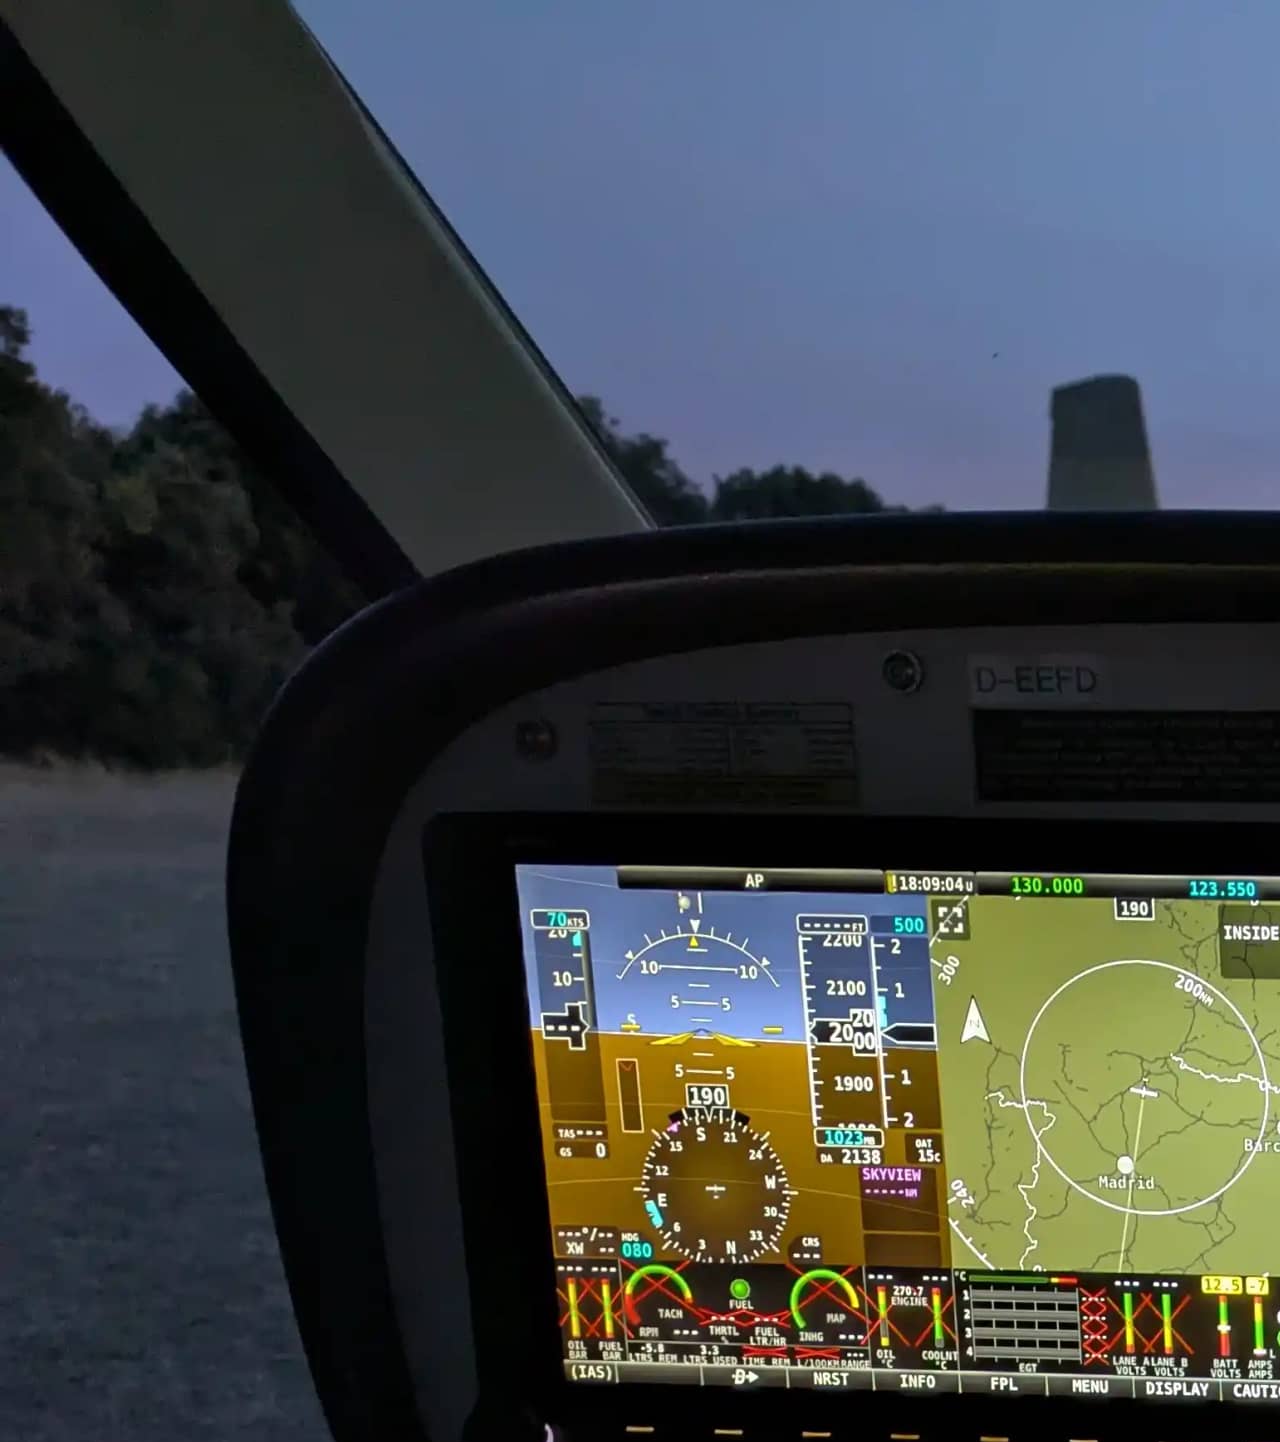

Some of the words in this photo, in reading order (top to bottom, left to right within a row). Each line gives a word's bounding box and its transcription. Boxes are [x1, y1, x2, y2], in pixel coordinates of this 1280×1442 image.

[975, 666, 1098, 693] D-EEFD
[745, 874, 764, 888] AP
[1012, 877, 1083, 894] 130.000
[1190, 880, 1256, 897] 123.550
[1120, 901, 1149, 916] 190
[894, 918, 924, 933] 500
[1223, 925, 1280, 940] INSIDE
[822, 934, 862, 948] 2200
[552, 972, 572, 986] 10
[826, 981, 866, 996] 2100
[834, 1076, 873, 1092] 1900
[690, 1088, 725, 1105] 190
[842, 1149, 881, 1164] 2138
[863, 1168, 922, 1182] SKYVIEW
[1099, 1176, 1154, 1189] Madrid
[566, 1242, 584, 1255] XW
[803, 1237, 820, 1247] CRS
[622, 1242, 652, 1257] 080
[893, 1286, 924, 1296] 270.7
[1203, 1278, 1240, 1292] 12.5
[730, 1300, 753, 1310] FUEL
[891, 1297, 928, 1306] ENGINE
[658, 1309, 683, 1319] TACH
[827, 1314, 846, 1323] MAP
[639, 1327, 658, 1337] RPM
[568, 1341, 587, 1351] OIL
[922, 1351, 958, 1361] COOLNT
[1019, 1364, 1038, 1373] EGT
[1214, 1360, 1238, 1369] BATT
[1249, 1360, 1272, 1370] AMPS
[571, 1366, 612, 1381] (IAS)
[814, 1372, 849, 1386] NRST
[1211, 1369, 1241, 1379] VOLTS
[1249, 1370, 1273, 1380] AMPS
[900, 1375, 936, 1389] INFO
[991, 1378, 1018, 1391] FPL
[1073, 1380, 1109, 1393] MENU
[1146, 1382, 1208, 1397] DISPLAY
